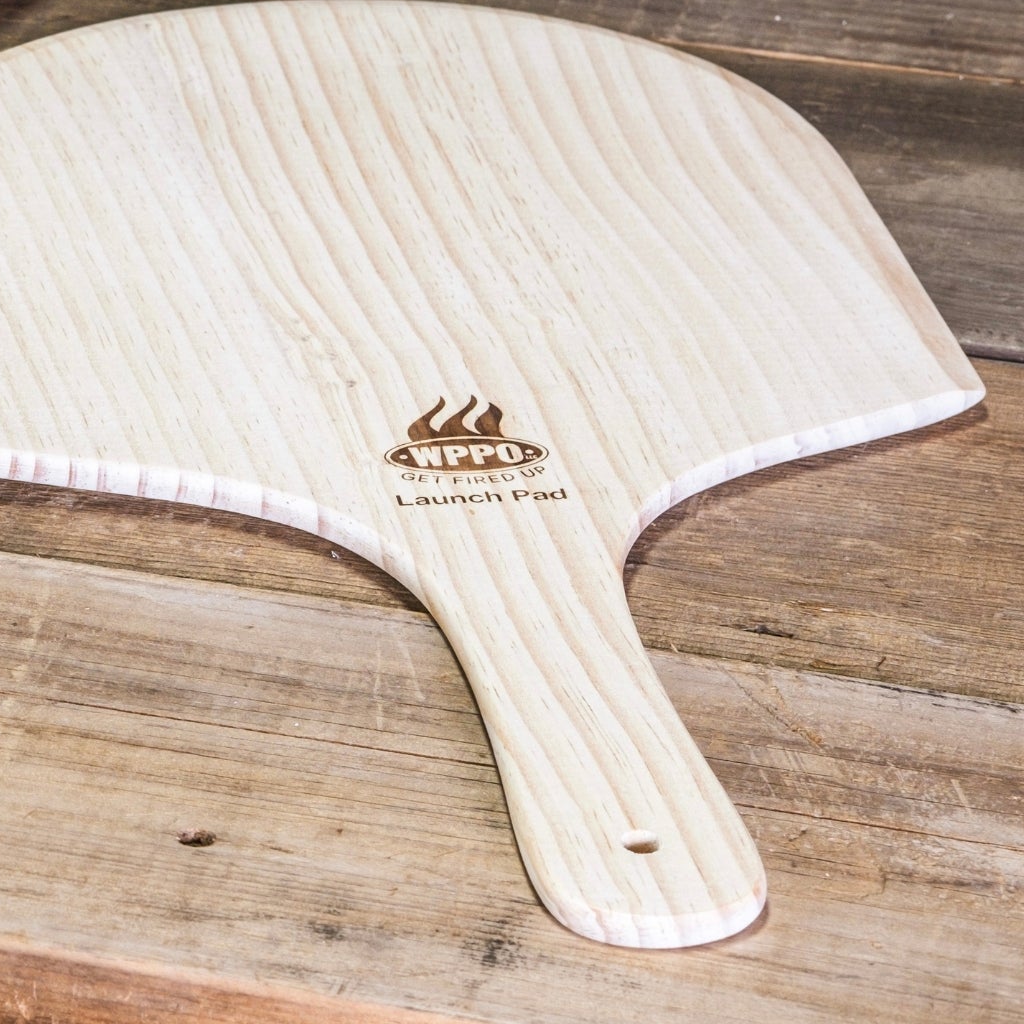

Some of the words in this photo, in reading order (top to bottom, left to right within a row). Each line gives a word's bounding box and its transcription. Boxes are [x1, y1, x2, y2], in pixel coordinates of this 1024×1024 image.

[408, 442, 524, 467] WPPO
[401, 472, 443, 484] GET
[453, 472, 515, 485] FIRED
[520, 466, 546, 478] UP
[396, 491, 503, 507] Launch
[511, 487, 568, 502] Pad
